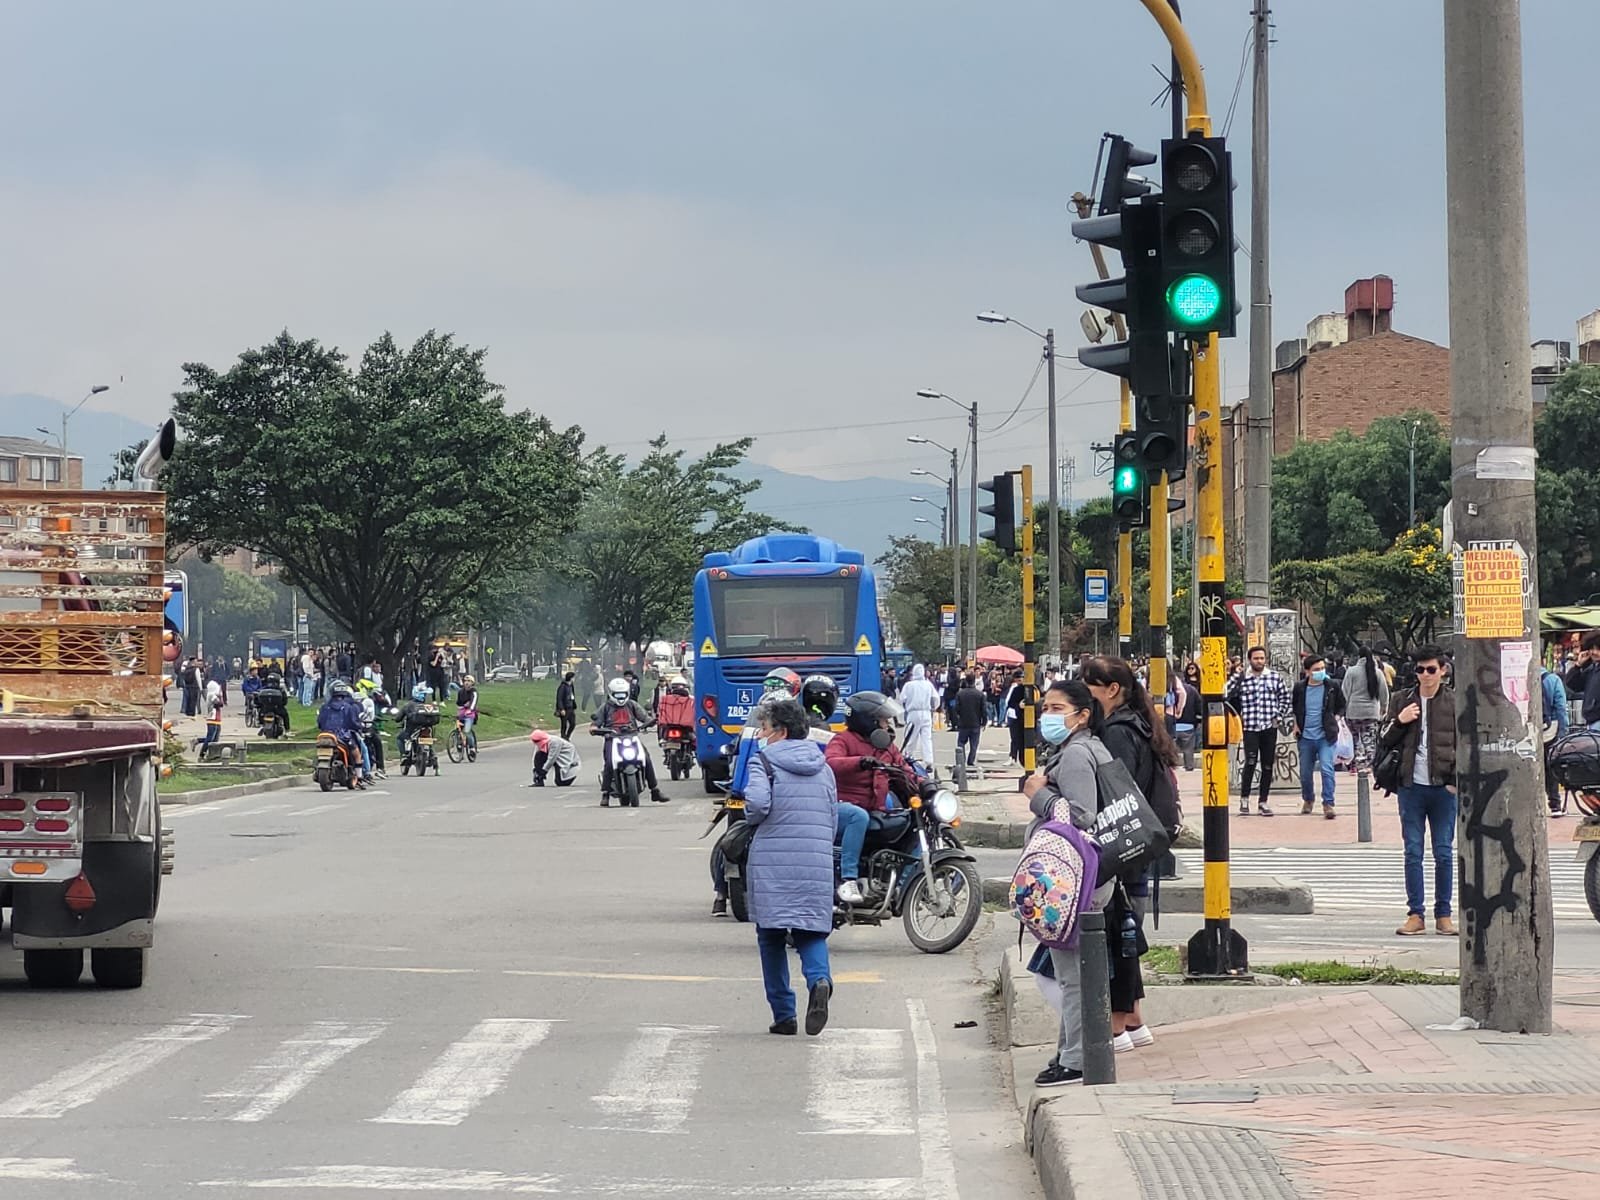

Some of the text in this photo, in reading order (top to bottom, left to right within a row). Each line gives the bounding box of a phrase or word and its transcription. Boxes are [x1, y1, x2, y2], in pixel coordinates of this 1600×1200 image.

[1466, 561, 1520, 571] NATURAL
[1466, 585, 1521, 595] LA DIABETES
[1475, 597, 1500, 606] TIENES
[1501, 596, 1521, 605] CURA
[728, 706, 757, 717] Z80-7
